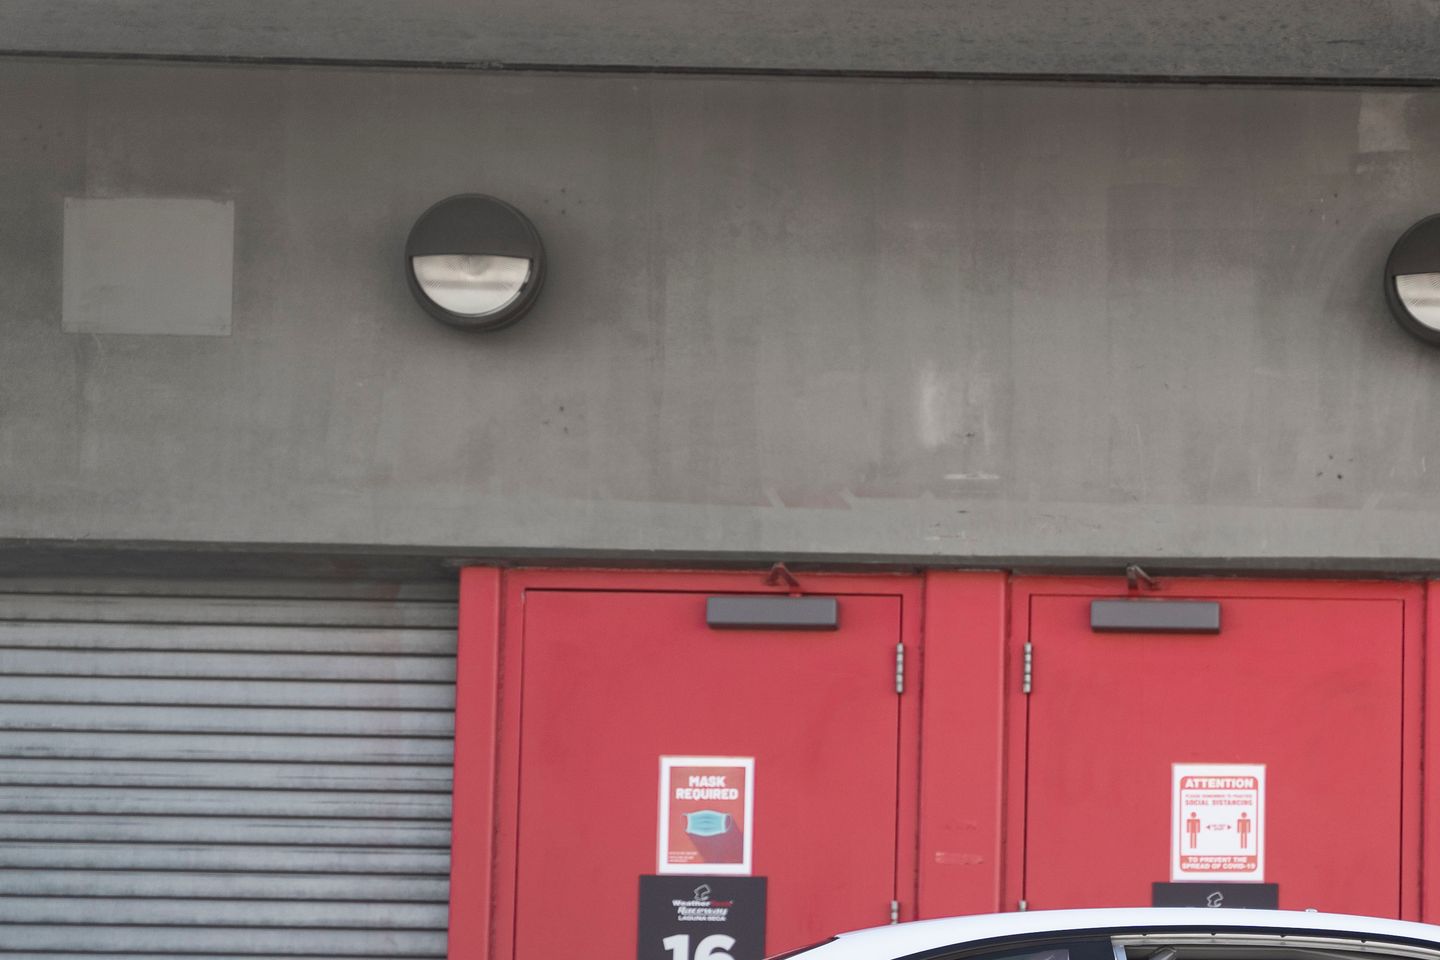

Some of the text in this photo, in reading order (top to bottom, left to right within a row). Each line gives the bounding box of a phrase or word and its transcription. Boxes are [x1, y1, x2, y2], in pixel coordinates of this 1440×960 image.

[688, 775, 726, 788] MASK
[1184, 778, 1254, 789] ATTENTION
[675, 788, 739, 801] REQUIRED
